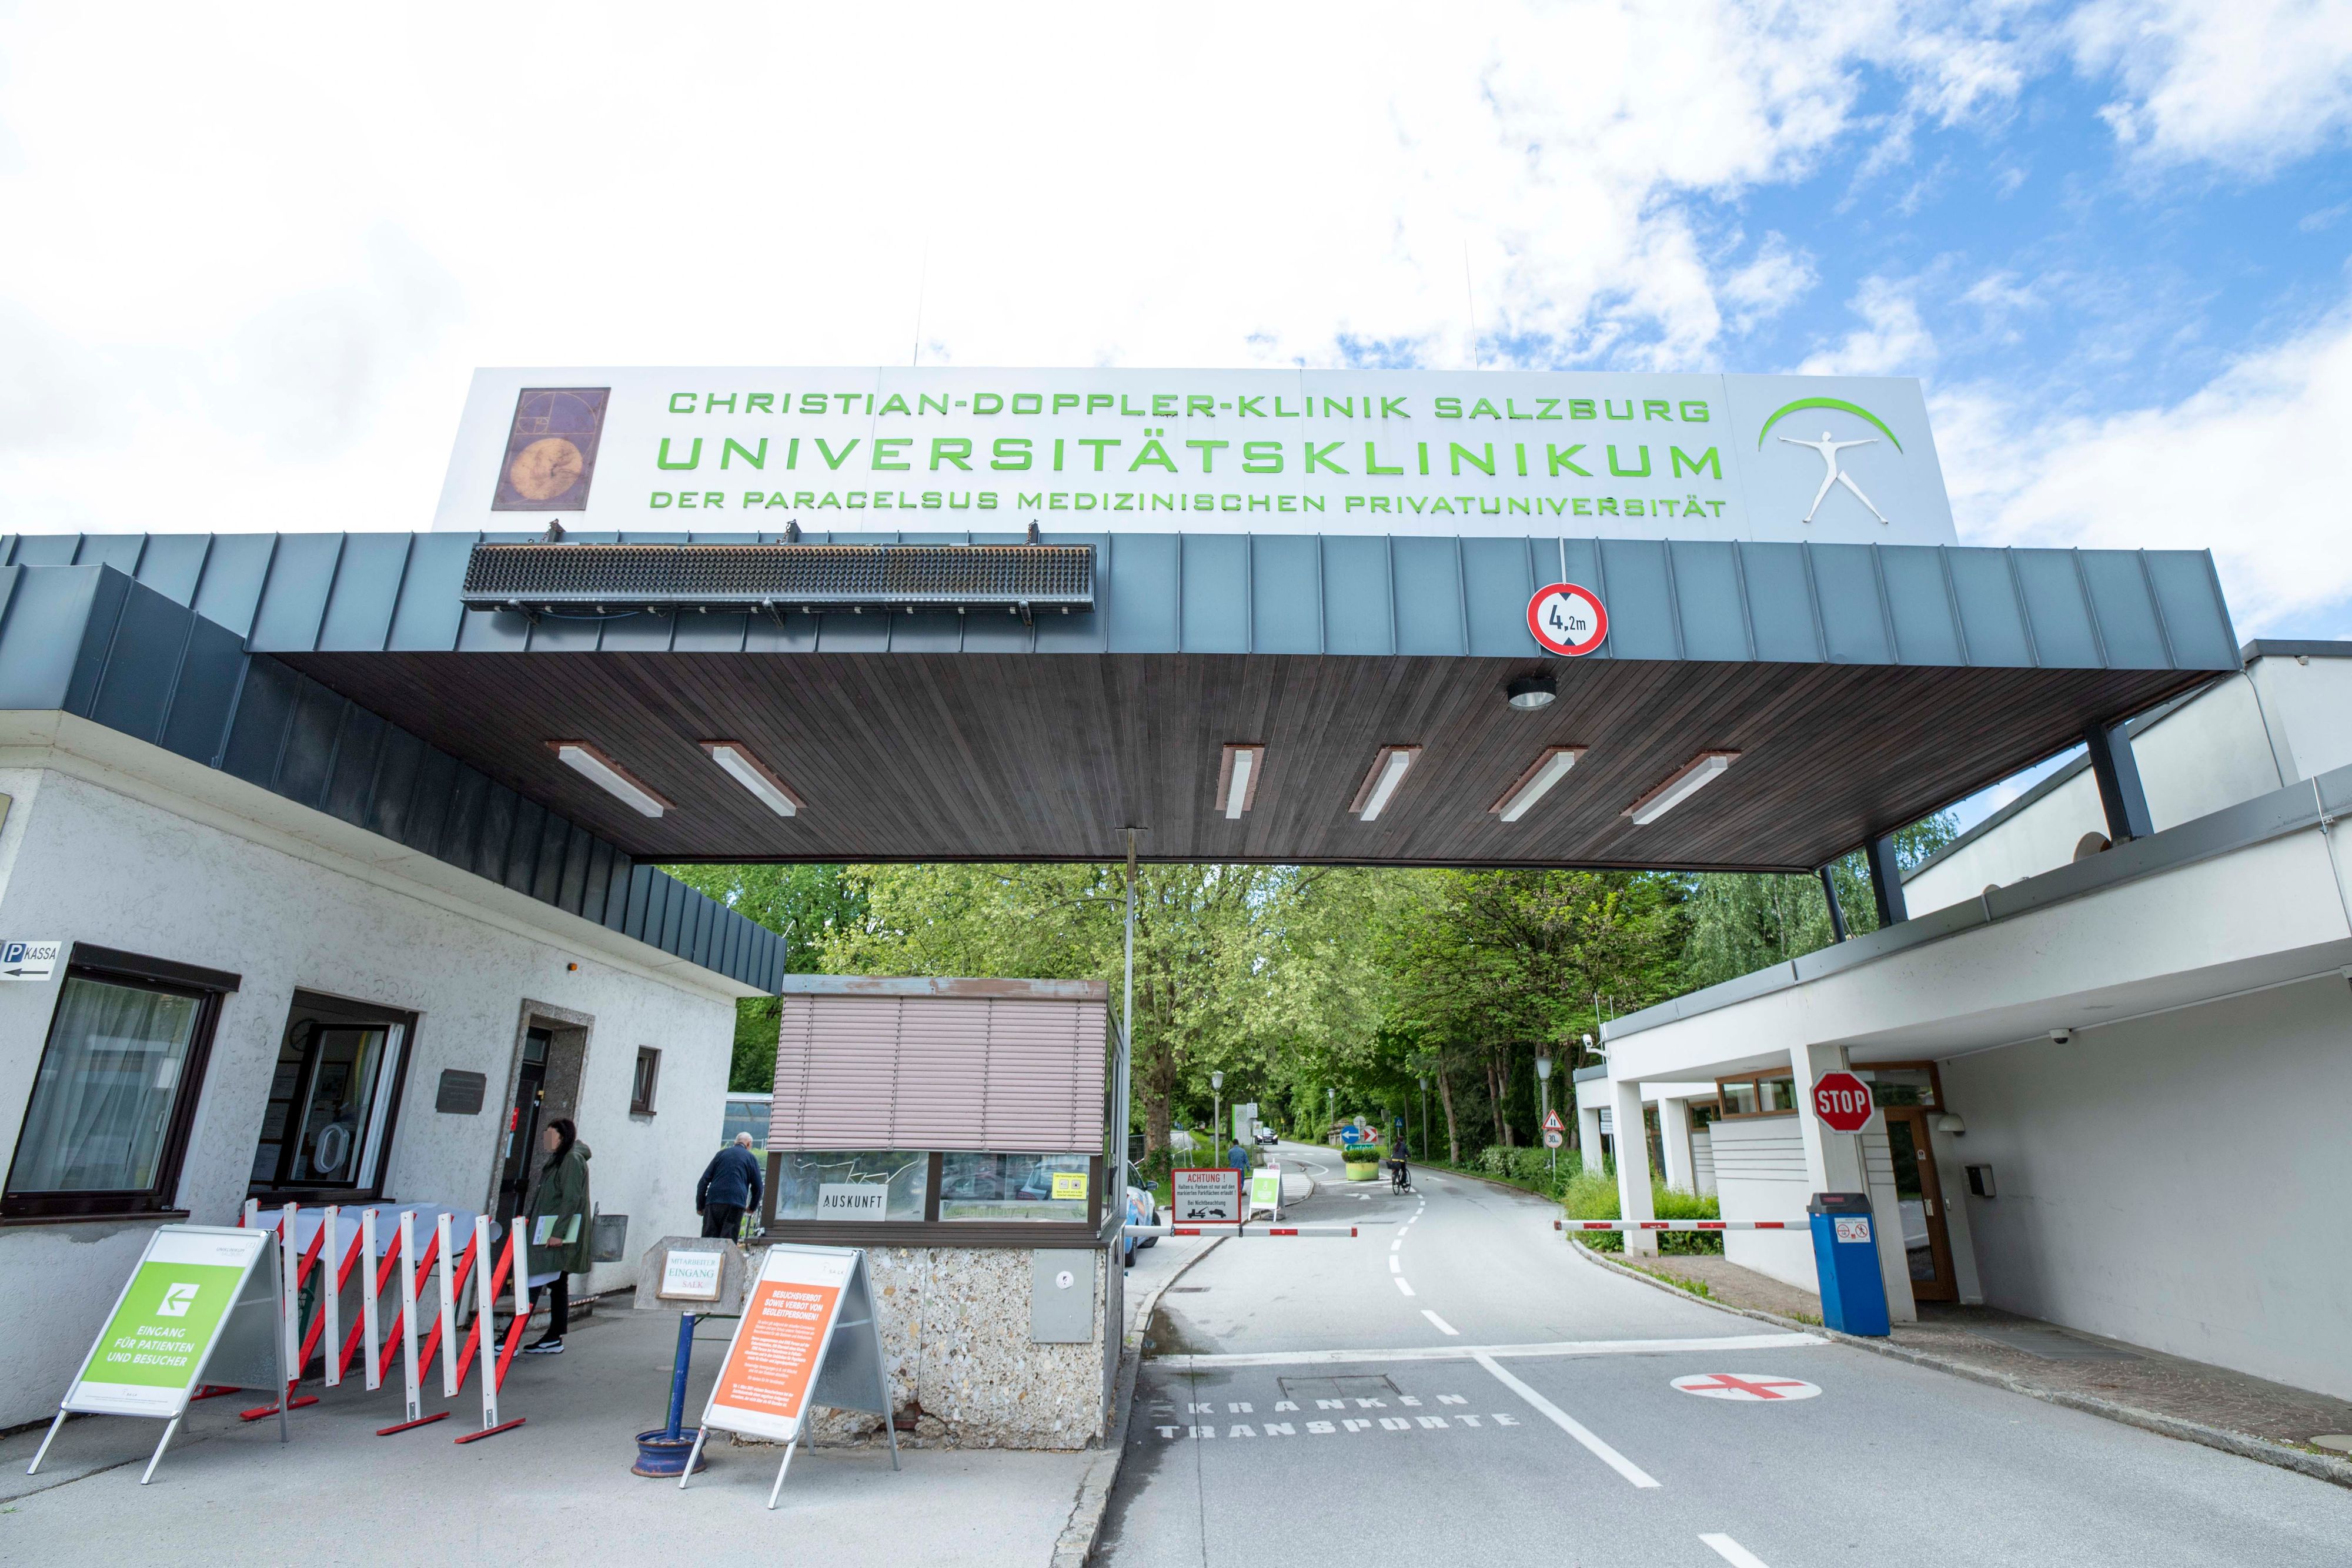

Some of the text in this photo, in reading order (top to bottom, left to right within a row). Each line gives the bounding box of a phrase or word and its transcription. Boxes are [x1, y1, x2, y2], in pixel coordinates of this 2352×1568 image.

[669, 393, 1710, 422] CHRISTIAN-DOPPLER-KLINIK SALZBURG
[657, 427, 1729, 479] UNIVERSITÄTSKLINIKUM
[649, 491, 1725, 517] DER PARACELSUS MEDIZINISCHEN PRIVATUNIVERSITÄT
[1549, 604, 1586, 632] 4,2m
[6, 944, 56, 961] P KASSA
[1818, 1089, 1866, 1114] STOP
[1187, 1174, 1220, 1182] ACHTUNG
[823, 1195, 882, 1208] AUSKUNFT
[669, 1268, 714, 1278] EINGANG
[772, 1290, 822, 1302] BESUCHSVERBOT
[764, 1299, 823, 1312] SOWIE VERBOT VON
[762, 1308, 819, 1321] BEGLEITPERSONEN!
[136, 1325, 186, 1338] EINGANG
[113, 1336, 195, 1352] FÜR PATIENTEN
[107, 1352, 188, 1366] UND BESUCHER
[1188, 1394, 1468, 1413] KRANKEN
[1155, 1413, 1520, 1438] TRANSPORTE
